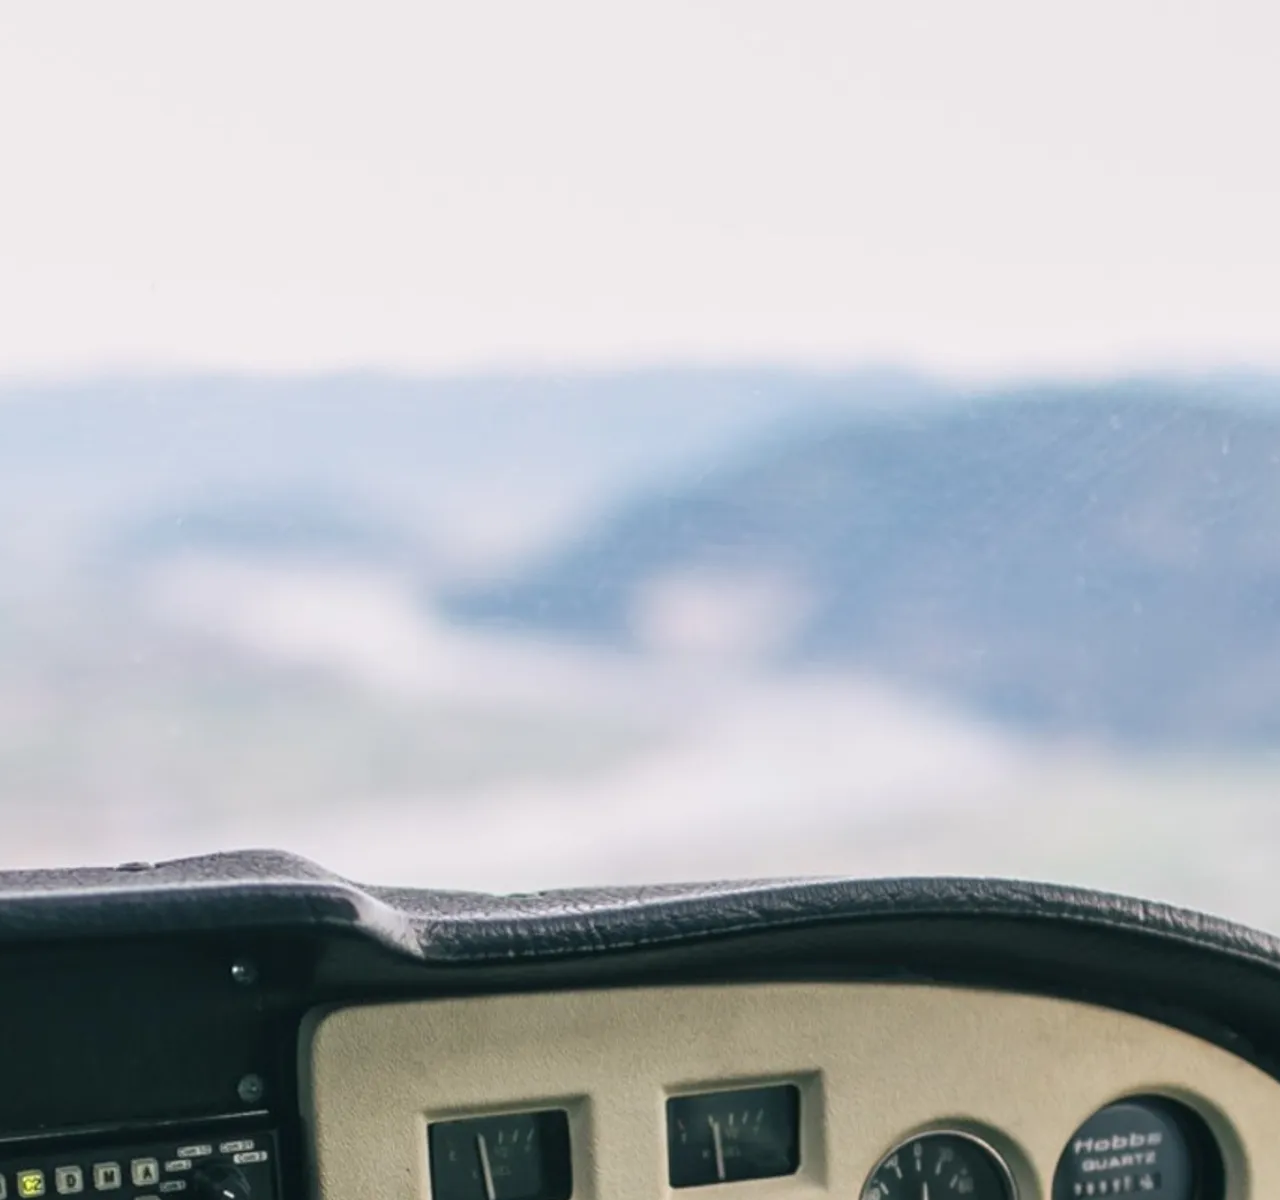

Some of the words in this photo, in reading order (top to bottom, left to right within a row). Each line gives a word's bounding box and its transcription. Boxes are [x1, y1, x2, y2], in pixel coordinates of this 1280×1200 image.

[1074, 1132, 1163, 1155] Hobbs
[1081, 1151, 1156, 1172] QUARTZ
[104, 1171, 114, 1183] M
[143, 1167, 152, 1179] A
[23, 1178, 42, 1192] C2
[66, 1174, 76, 1187] D
